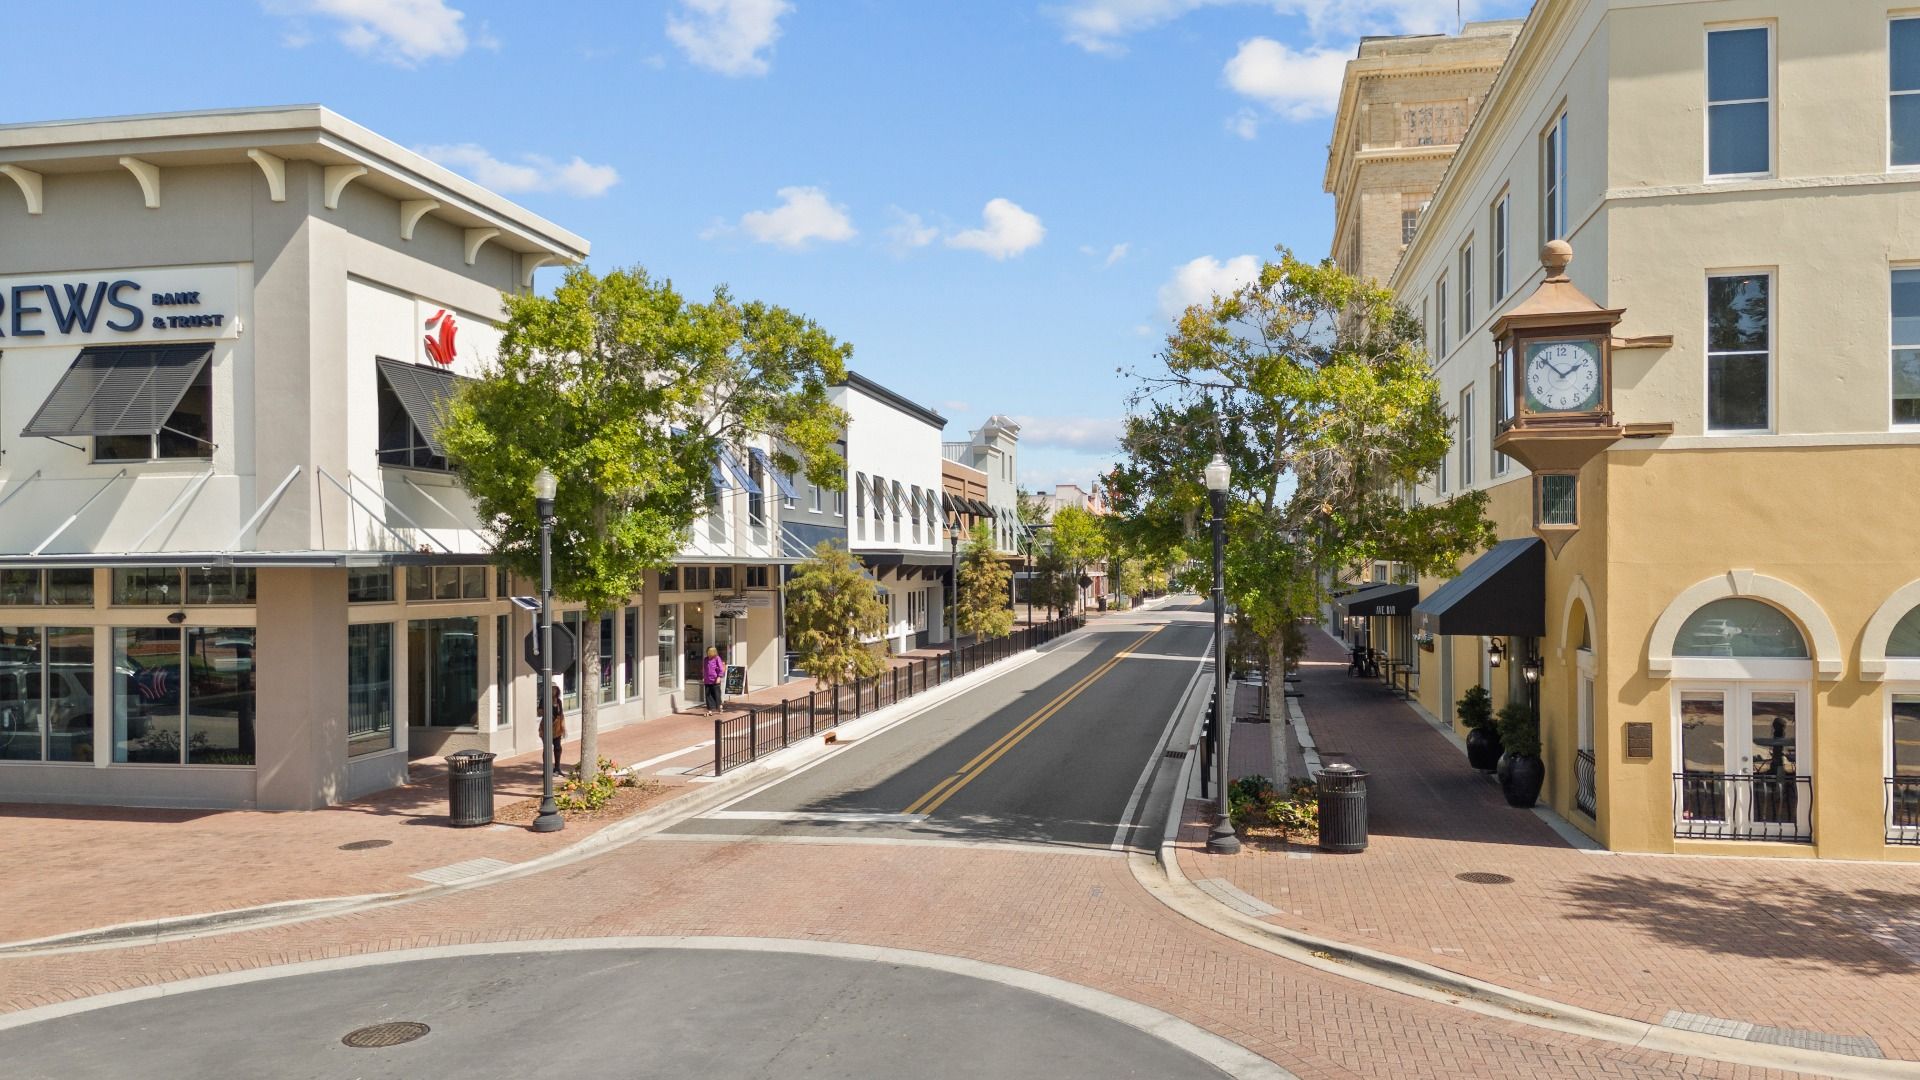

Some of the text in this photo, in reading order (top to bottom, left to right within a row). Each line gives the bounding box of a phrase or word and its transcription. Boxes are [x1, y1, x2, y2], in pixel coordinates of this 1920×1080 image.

[152, 291, 200, 305] BANK
[0, 280, 144, 337] EWS
[152, 314, 224, 329] & TRUST
[1546, 352, 1552, 360] 11
[1557, 347, 1567, 356] 12
[1536, 360, 1545, 370] 10
[1582, 358, 1589, 368] 2
[1532, 374, 1540, 382] 9
[1586, 370, 1593, 380] 3
[1536, 386, 1544, 394] 8
[1582, 384, 1590, 392] 4
[1546, 394, 1552, 404] 7
[1560, 396, 1567, 406] 6
[1573, 392, 1580, 402] 5
